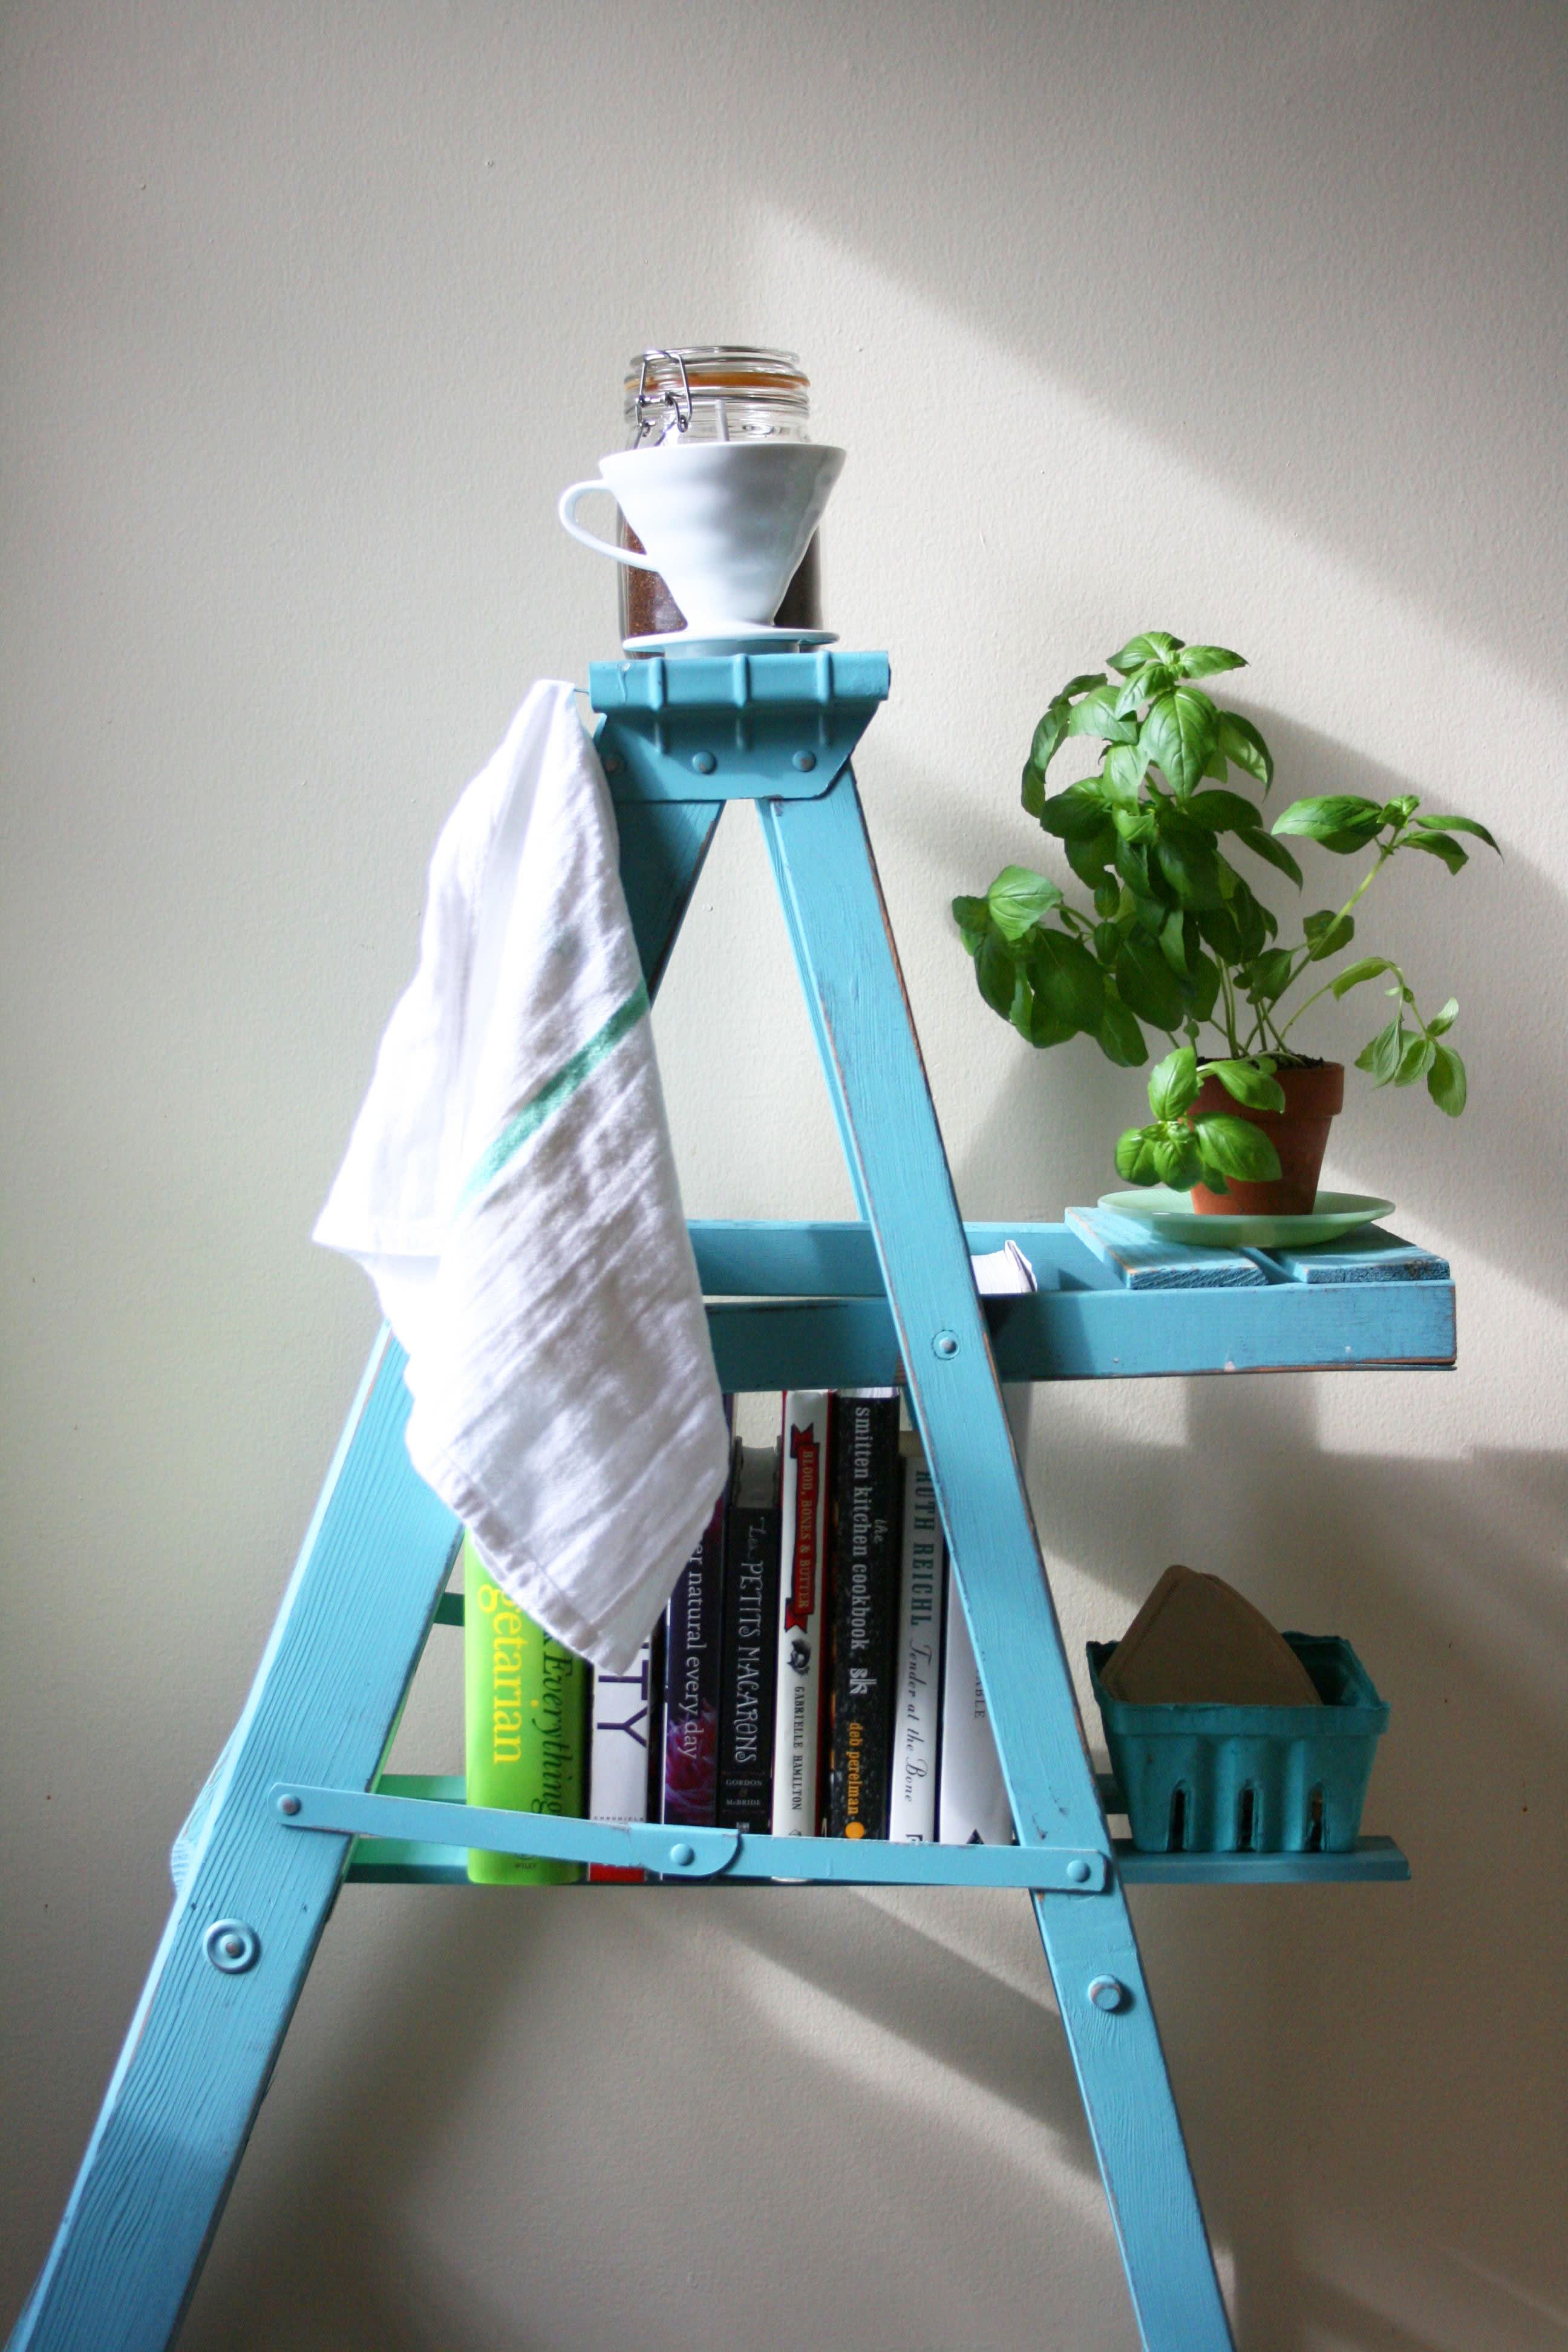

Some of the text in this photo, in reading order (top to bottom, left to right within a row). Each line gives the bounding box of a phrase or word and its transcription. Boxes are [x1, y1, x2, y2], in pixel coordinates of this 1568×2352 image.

[798, 1451, 814, 1609] BLOOD, BONES & BUTTER
[851, 1406, 873, 1650] smitten kitchen cookbook
[874, 1519, 887, 1544] the
[910, 1471, 936, 1626] RUTH REICHL
[687, 1572, 707, 1649] natural
[739, 1561, 764, 1637] PETITS
[477, 1583, 538, 1764] getarian
[596, 1643, 649, 1747] TY
[678, 1656, 701, 1716] every
[734, 1647, 760, 1763] MACARONS
[904, 1639, 933, 1802] Tender at the Bone
[531, 1651, 573, 1815] Everything
[677, 1722, 704, 1759] day
[791, 1686, 805, 1811] GABRIELLE HAMILTON
[846, 1722, 863, 1815] deb perelman
